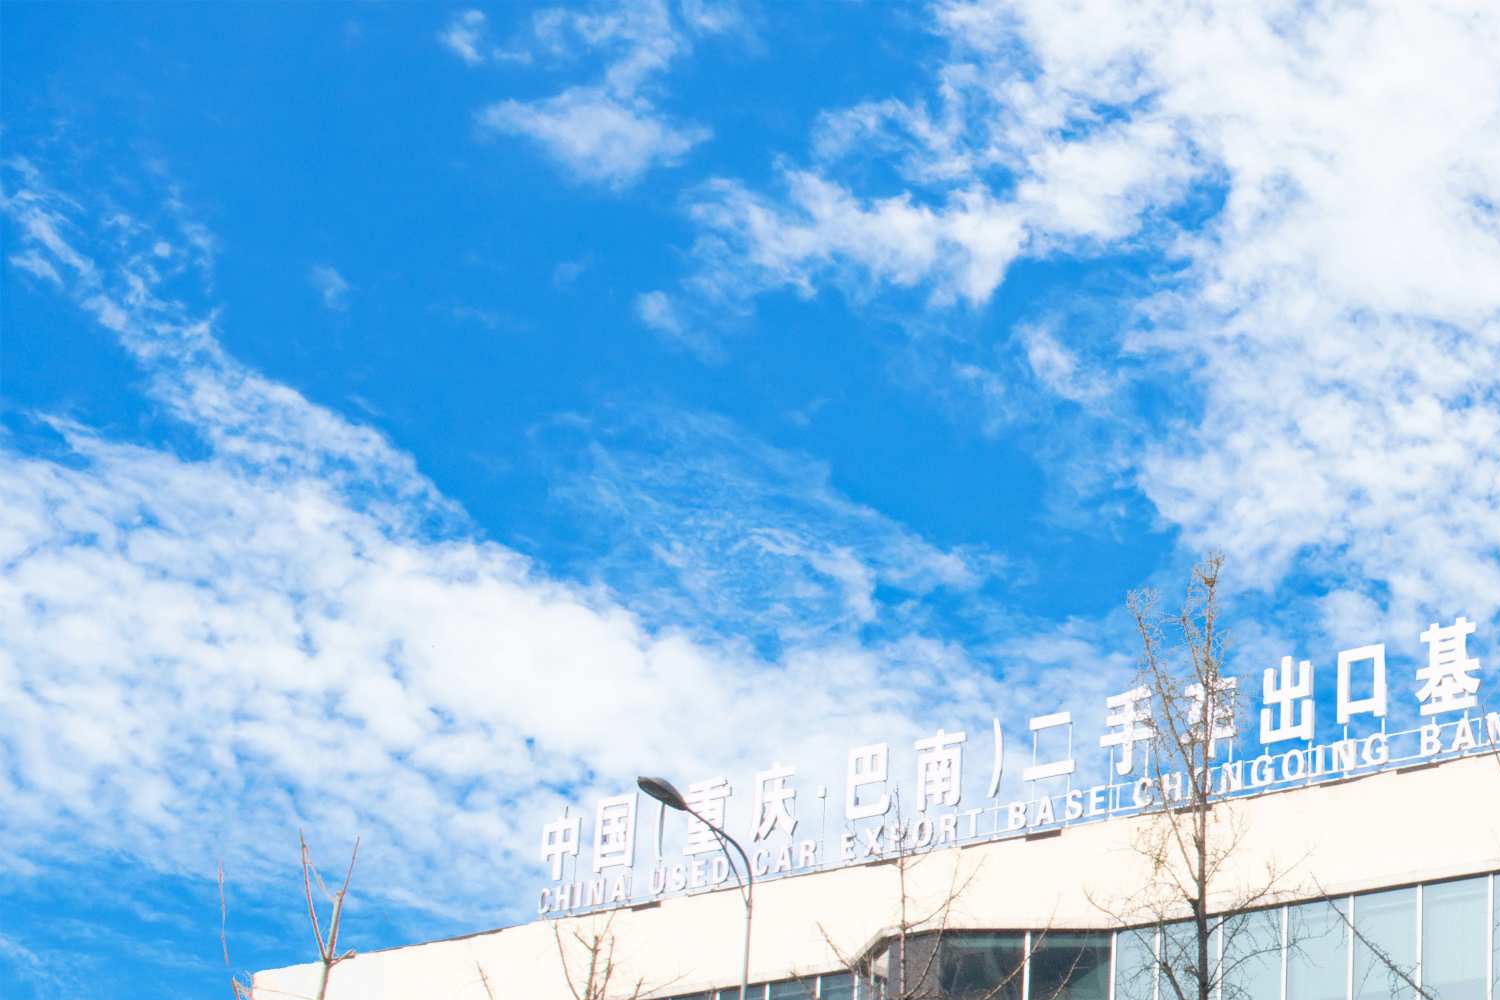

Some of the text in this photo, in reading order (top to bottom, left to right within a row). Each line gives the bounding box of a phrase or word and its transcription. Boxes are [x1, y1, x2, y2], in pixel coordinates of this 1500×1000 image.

[538, 874, 629, 914] CHINA
[651, 857, 729, 895] USED
[754, 840, 817, 876] CAR
[840, 809, 984, 860] EXPORT
[1008, 786, 1106, 830] BASE
